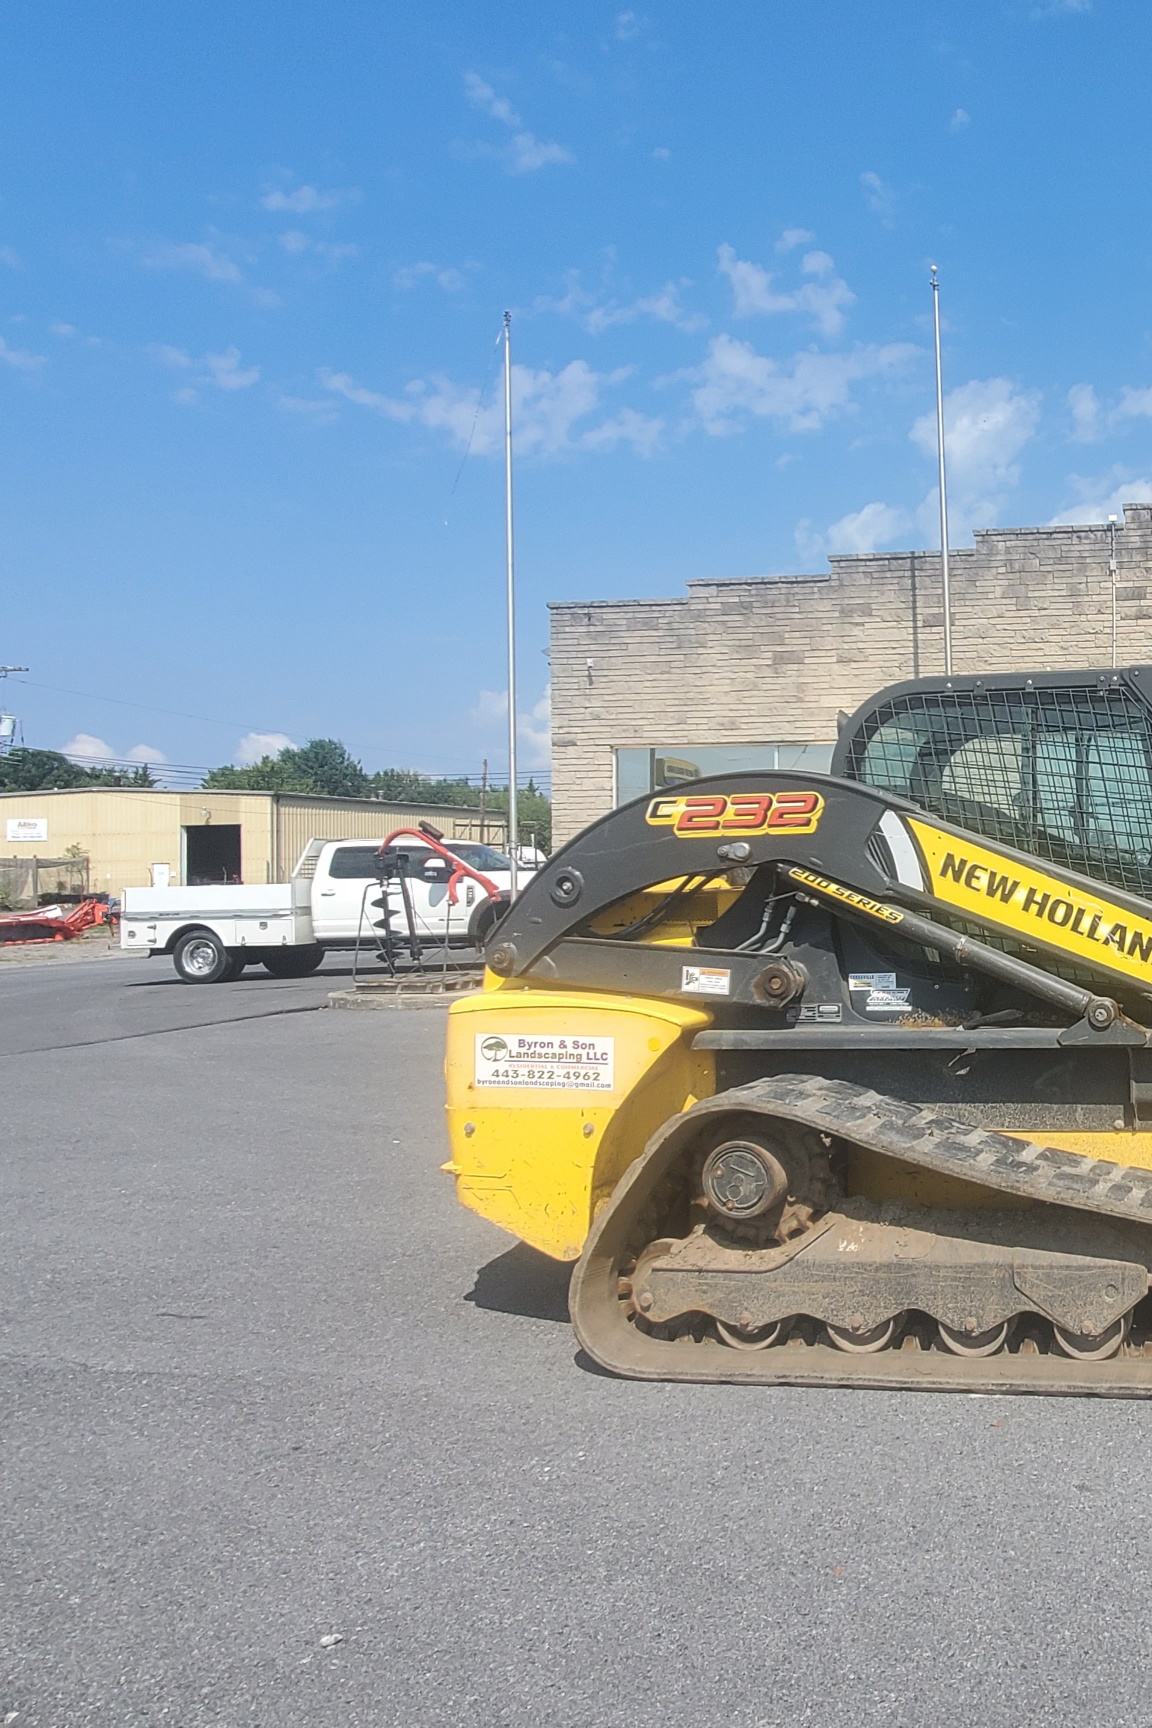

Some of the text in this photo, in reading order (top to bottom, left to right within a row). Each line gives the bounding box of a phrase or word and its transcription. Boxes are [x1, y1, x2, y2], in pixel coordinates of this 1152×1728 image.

[939, 852, 1021, 904] NEW
[791, 867, 902, 921] 200 SERIES
[518, 1039, 595, 1050] Byron & Son
[508, 1049, 608, 1062] Landscaping LLC
[491, 1069, 601, 1081] 443-822-4962
[477, 1079, 611, 1089] byronandsonlandscaping@gmail.com
